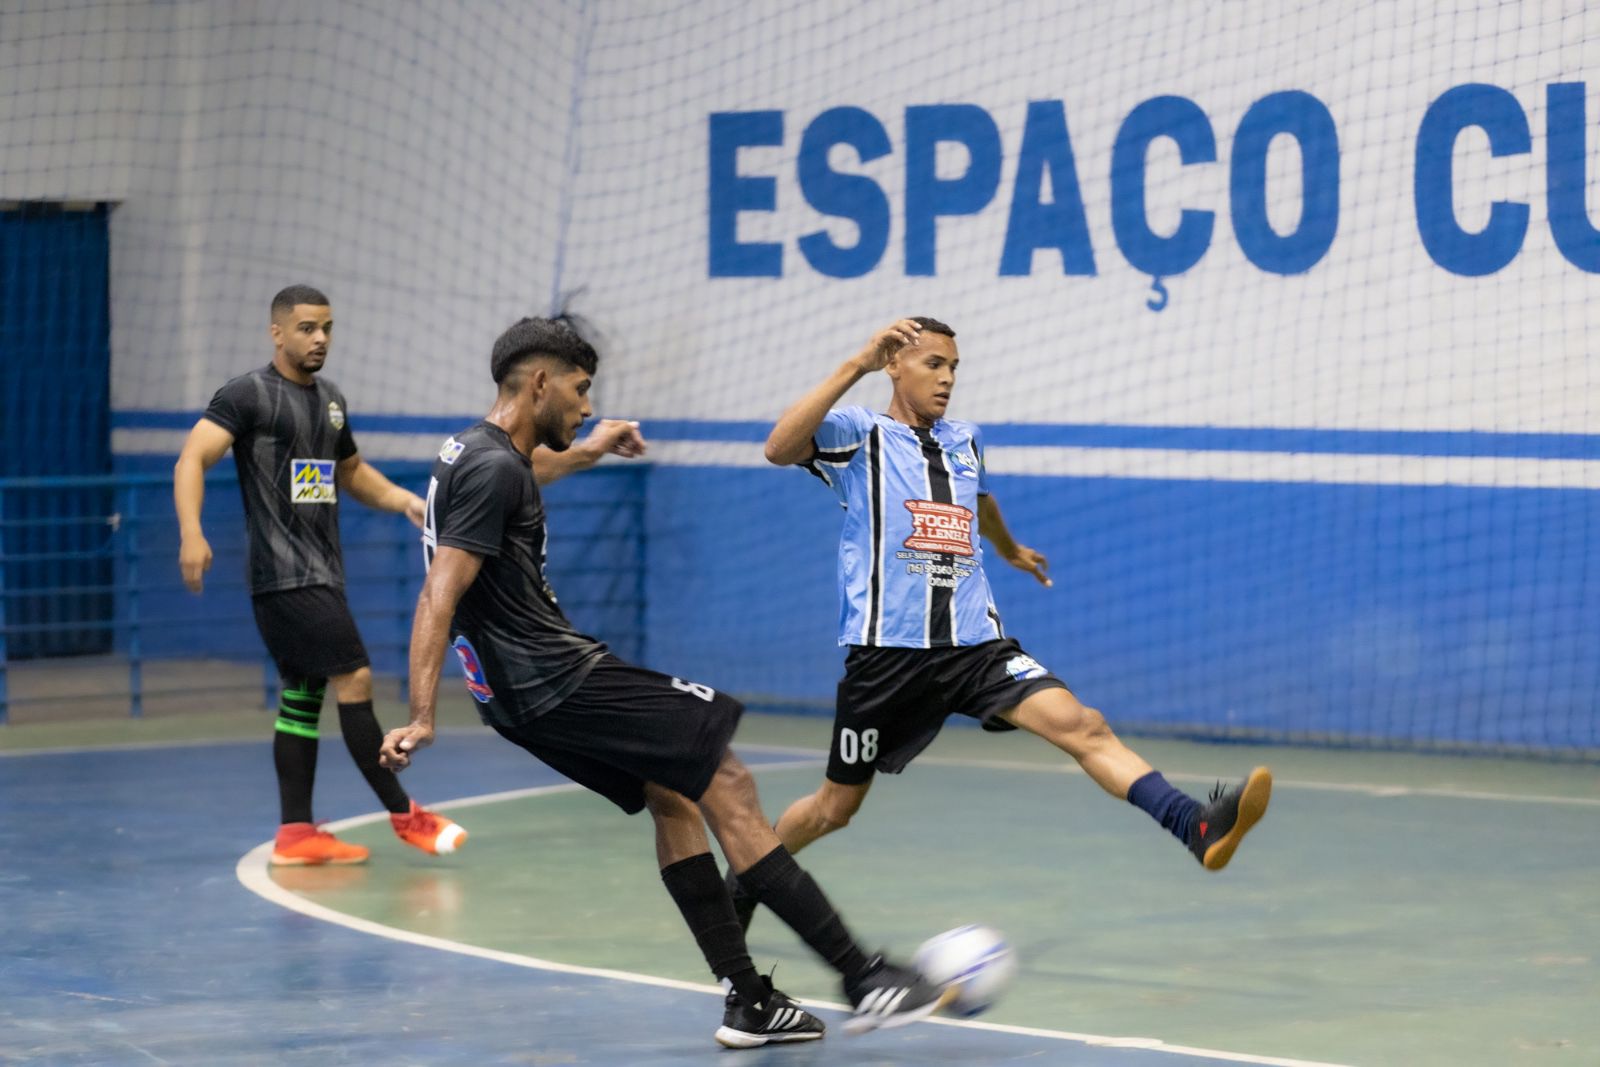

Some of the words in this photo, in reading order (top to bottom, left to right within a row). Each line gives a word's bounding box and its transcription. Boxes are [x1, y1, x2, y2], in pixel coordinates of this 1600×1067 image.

[708, 88, 1339, 312] ESPAÇO
[913, 513, 970, 532] FOGÃO
[927, 528, 970, 544] LENHA
[840, 727, 879, 764] 08
